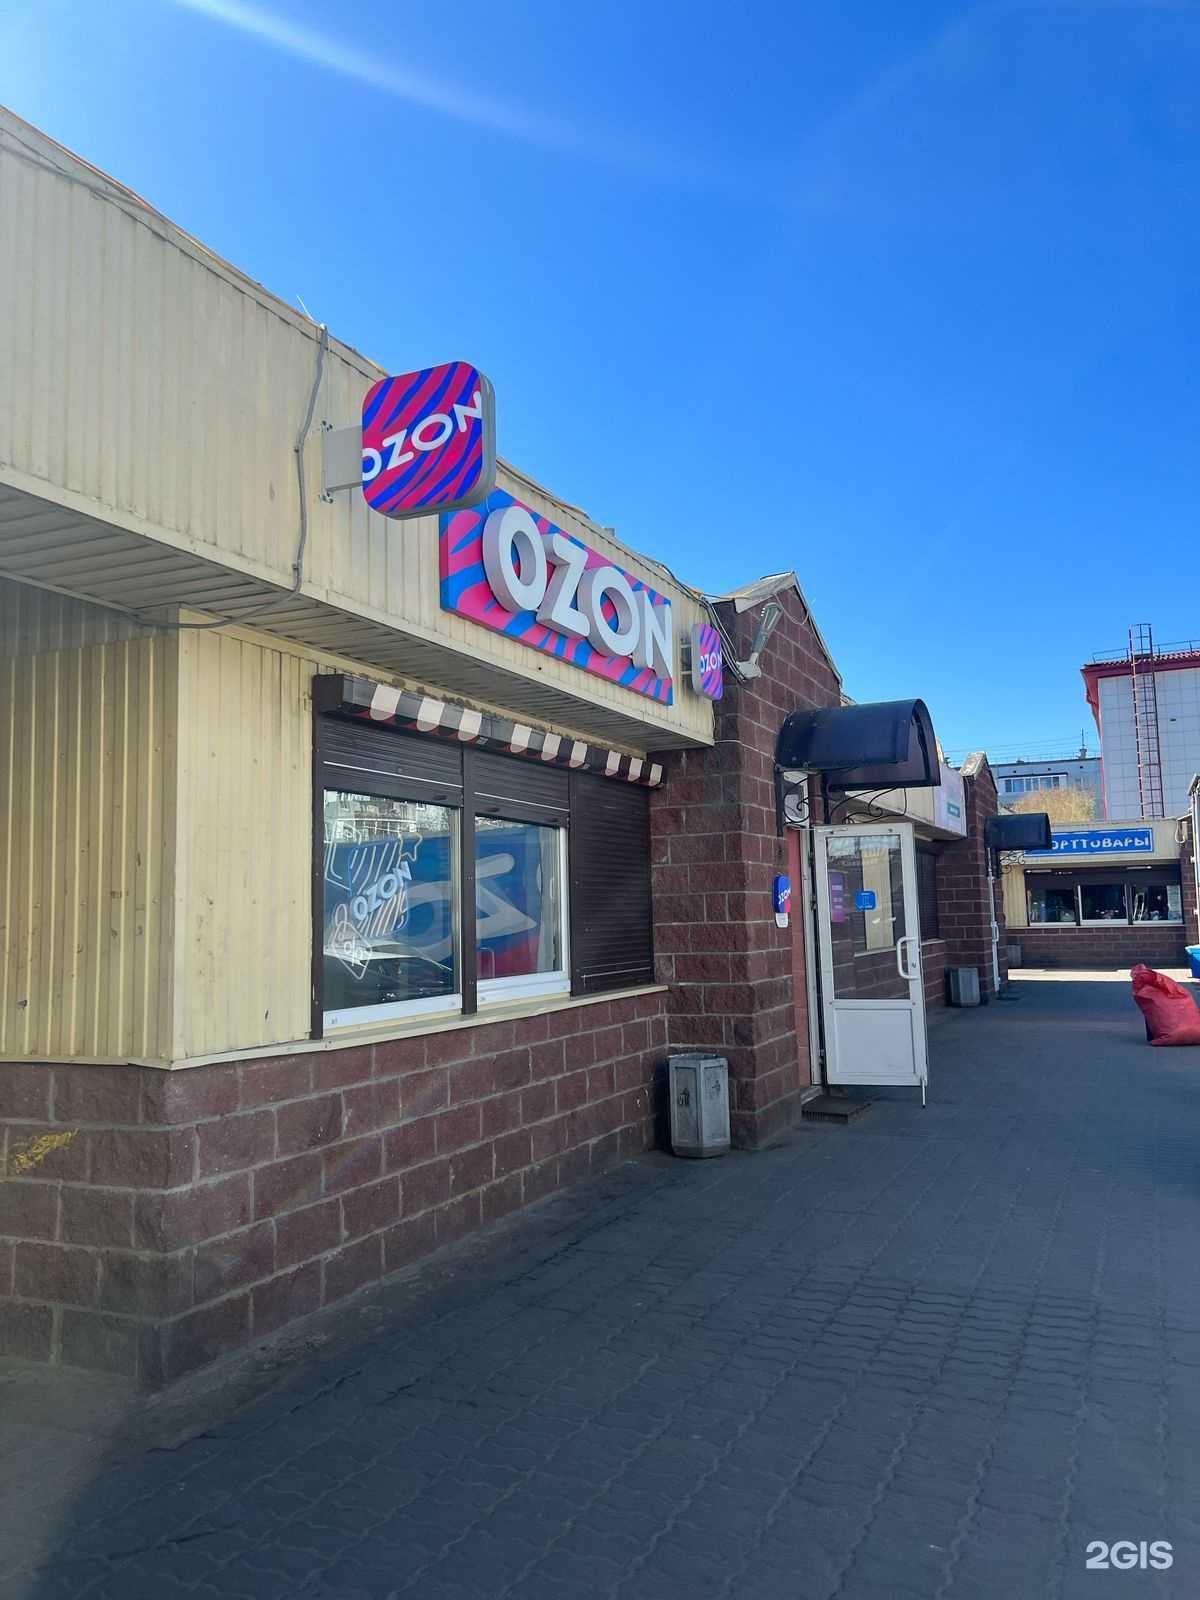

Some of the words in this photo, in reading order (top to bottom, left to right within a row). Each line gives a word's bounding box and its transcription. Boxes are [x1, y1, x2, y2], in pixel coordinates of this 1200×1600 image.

[482, 505, 672, 680] OZON
[1051, 837, 1149, 850] ОРТТОВАРЫ
[352, 860, 412, 920] OZON
